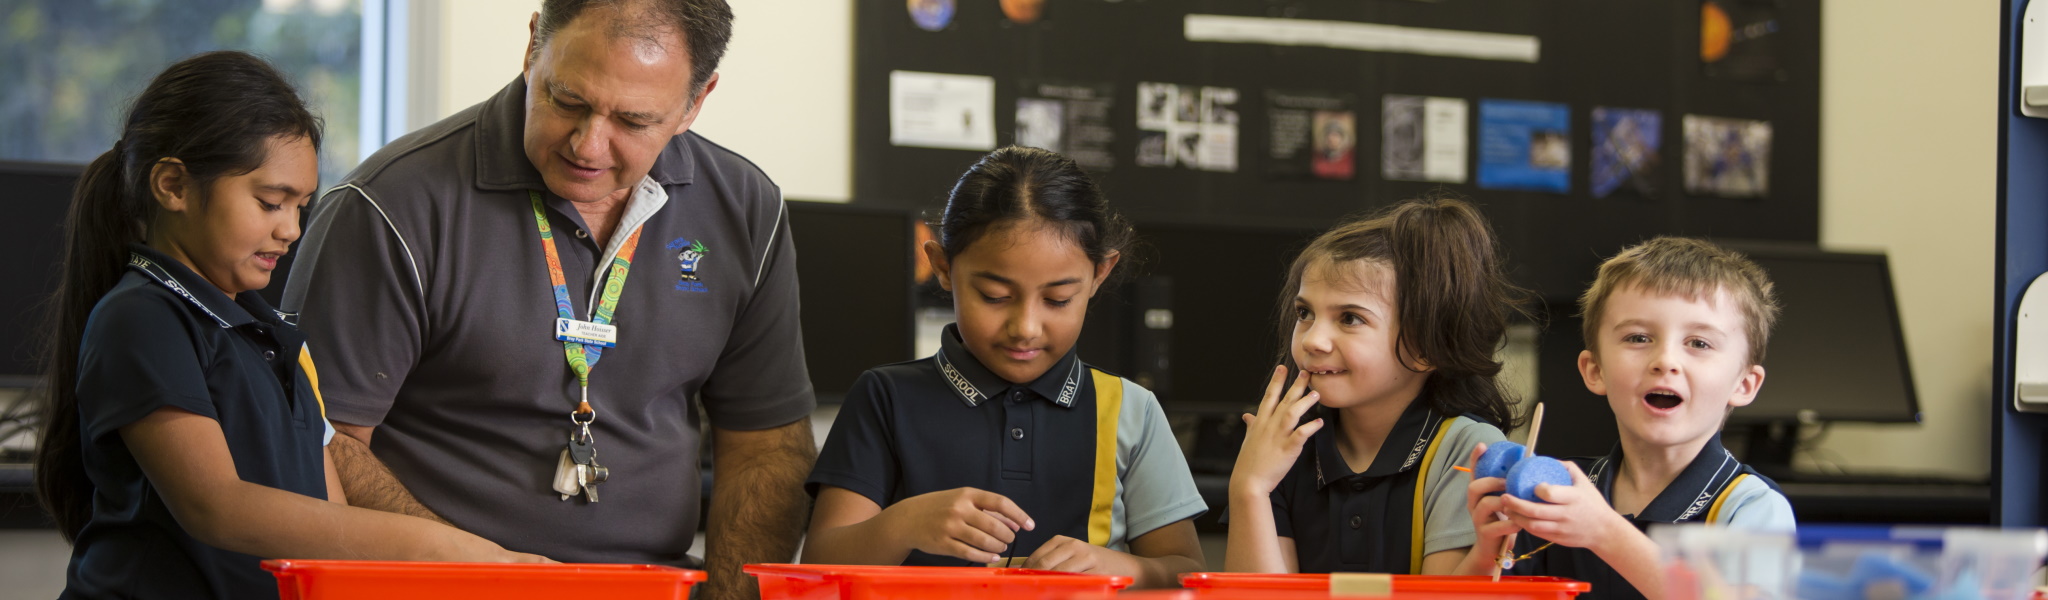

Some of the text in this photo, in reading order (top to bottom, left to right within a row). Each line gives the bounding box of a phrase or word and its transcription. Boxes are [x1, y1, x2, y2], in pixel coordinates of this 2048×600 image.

[130, 254, 151, 269] TATE
[944, 363, 979, 402] SCHOOL
[1060, 377, 1076, 404] BRAY
[1403, 438, 1427, 467] BRAY
[1680, 492, 1712, 519] BRAY
